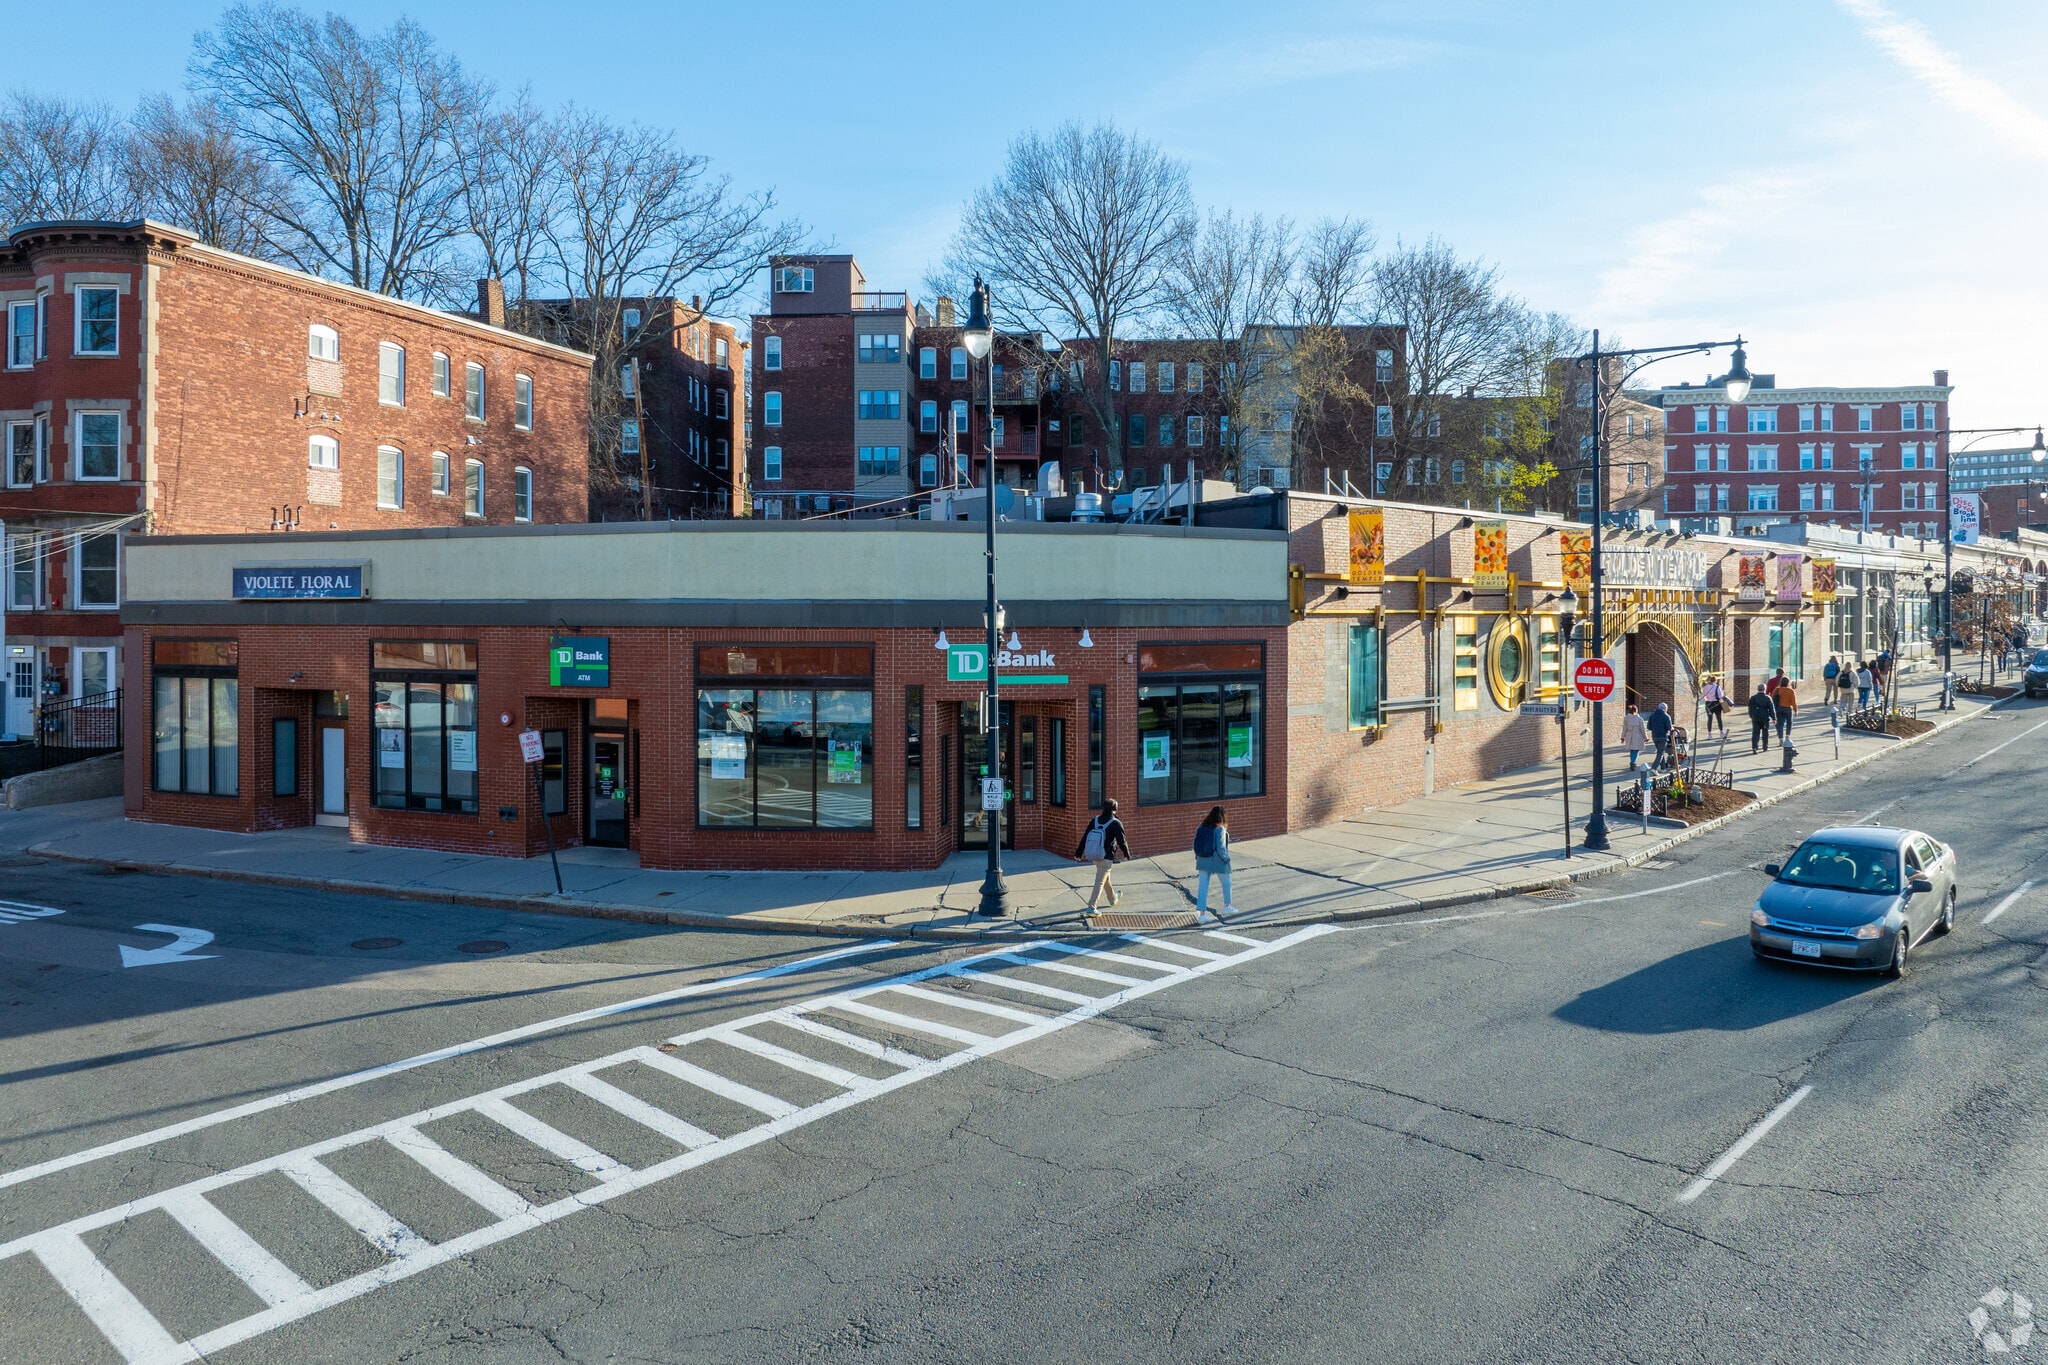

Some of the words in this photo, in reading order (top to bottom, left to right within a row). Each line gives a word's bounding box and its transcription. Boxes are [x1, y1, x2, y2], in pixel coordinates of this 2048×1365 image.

[1952, 497, 1973, 506] Disc
[1953, 508, 1976, 517] Brook
[243, 576, 295, 590] VIOLETE
[301, 575, 353, 589] FLORAL
[557, 651, 572, 663] TD
[575, 651, 604, 661] Bank
[951, 651, 984, 673] TD
[997, 650, 1056, 667] Bank
[1582, 666, 1592, 674] DO
[1594, 667, 1607, 675] NOT
[1583, 686, 1606, 694] ENTER
